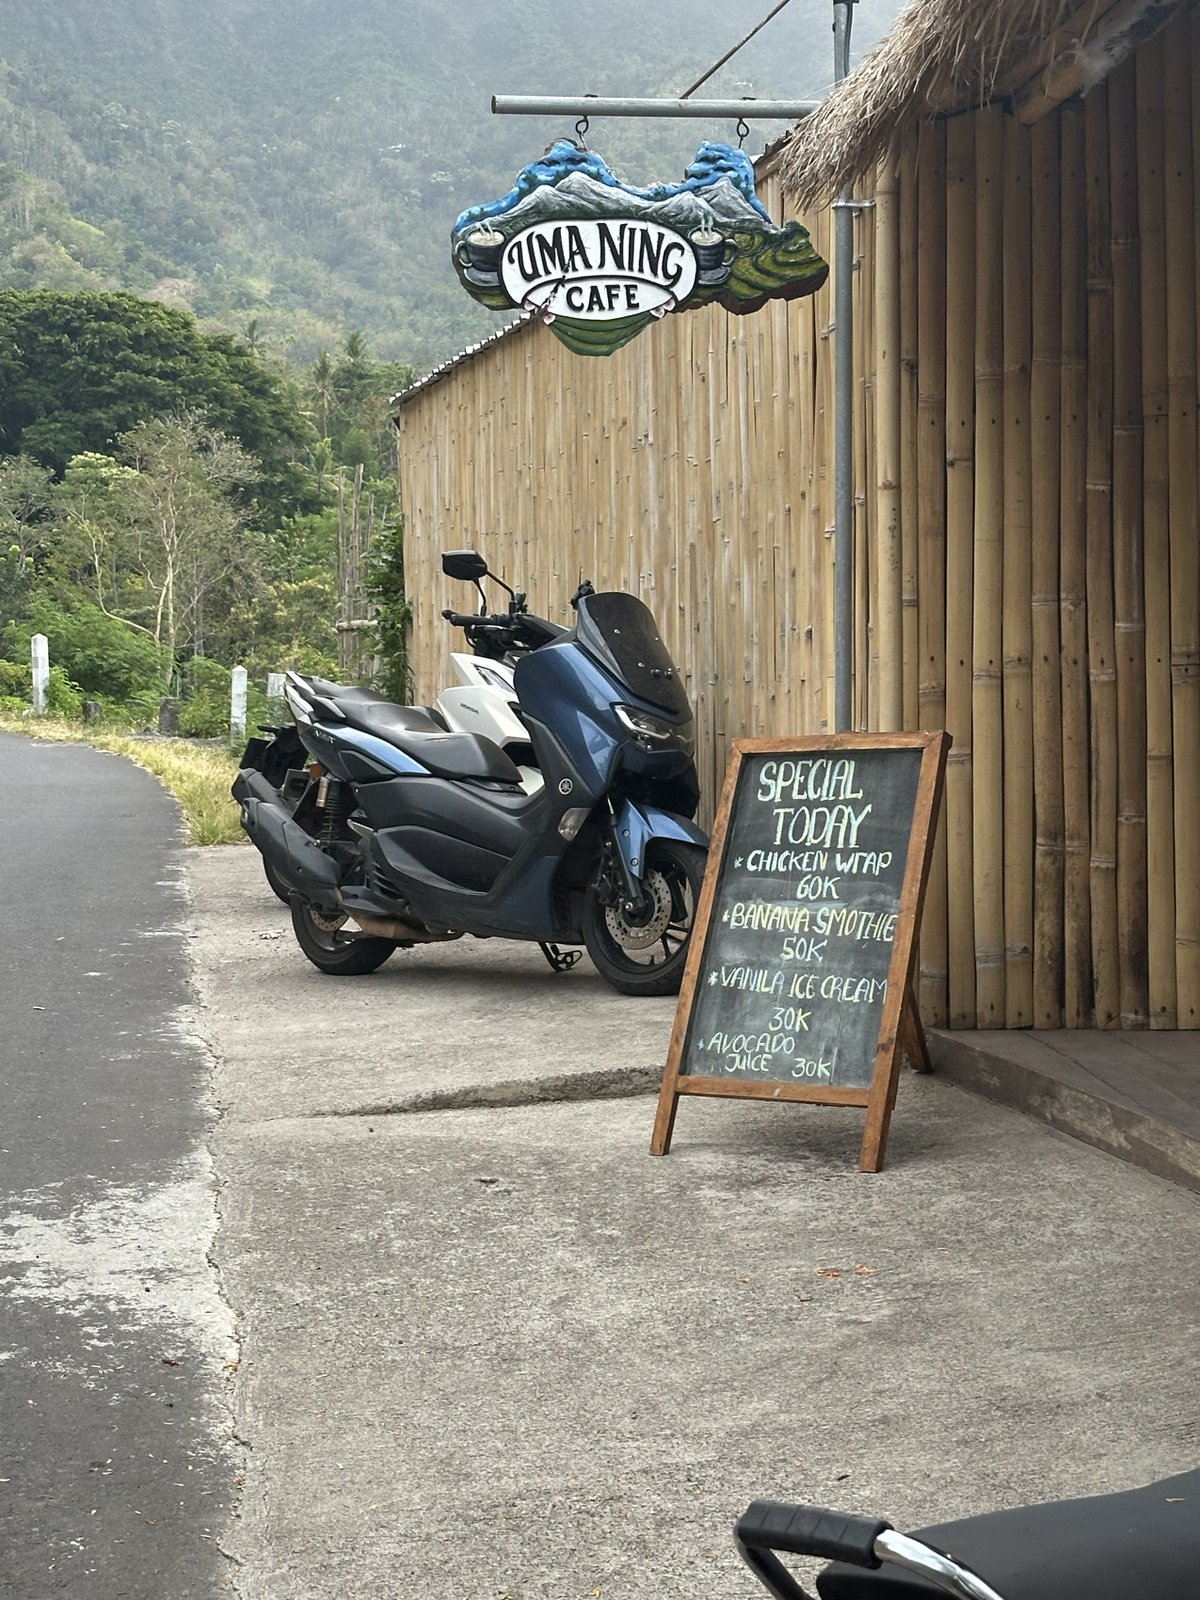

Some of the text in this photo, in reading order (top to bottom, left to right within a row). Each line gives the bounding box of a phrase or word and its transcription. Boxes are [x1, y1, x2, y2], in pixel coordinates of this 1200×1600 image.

[508, 223, 685, 288] UMA NING
[566, 284, 640, 312] CAFE
[757, 758, 863, 802] SPECIAL
[773, 804, 873, 848] TODAY
[746, 850, 829, 873] CHICKEN
[796, 874, 841, 900] 60K
[729, 902, 898, 942] BANANA SMOTHIE
[780, 936, 827, 962] 50K
[720, 966, 888, 1005] VANILA ICE CREAM
[768, 1006, 812, 1033] 30K
[707, 1031, 795, 1054] AVOCADO
[791, 1057, 831, 1079] 30K
